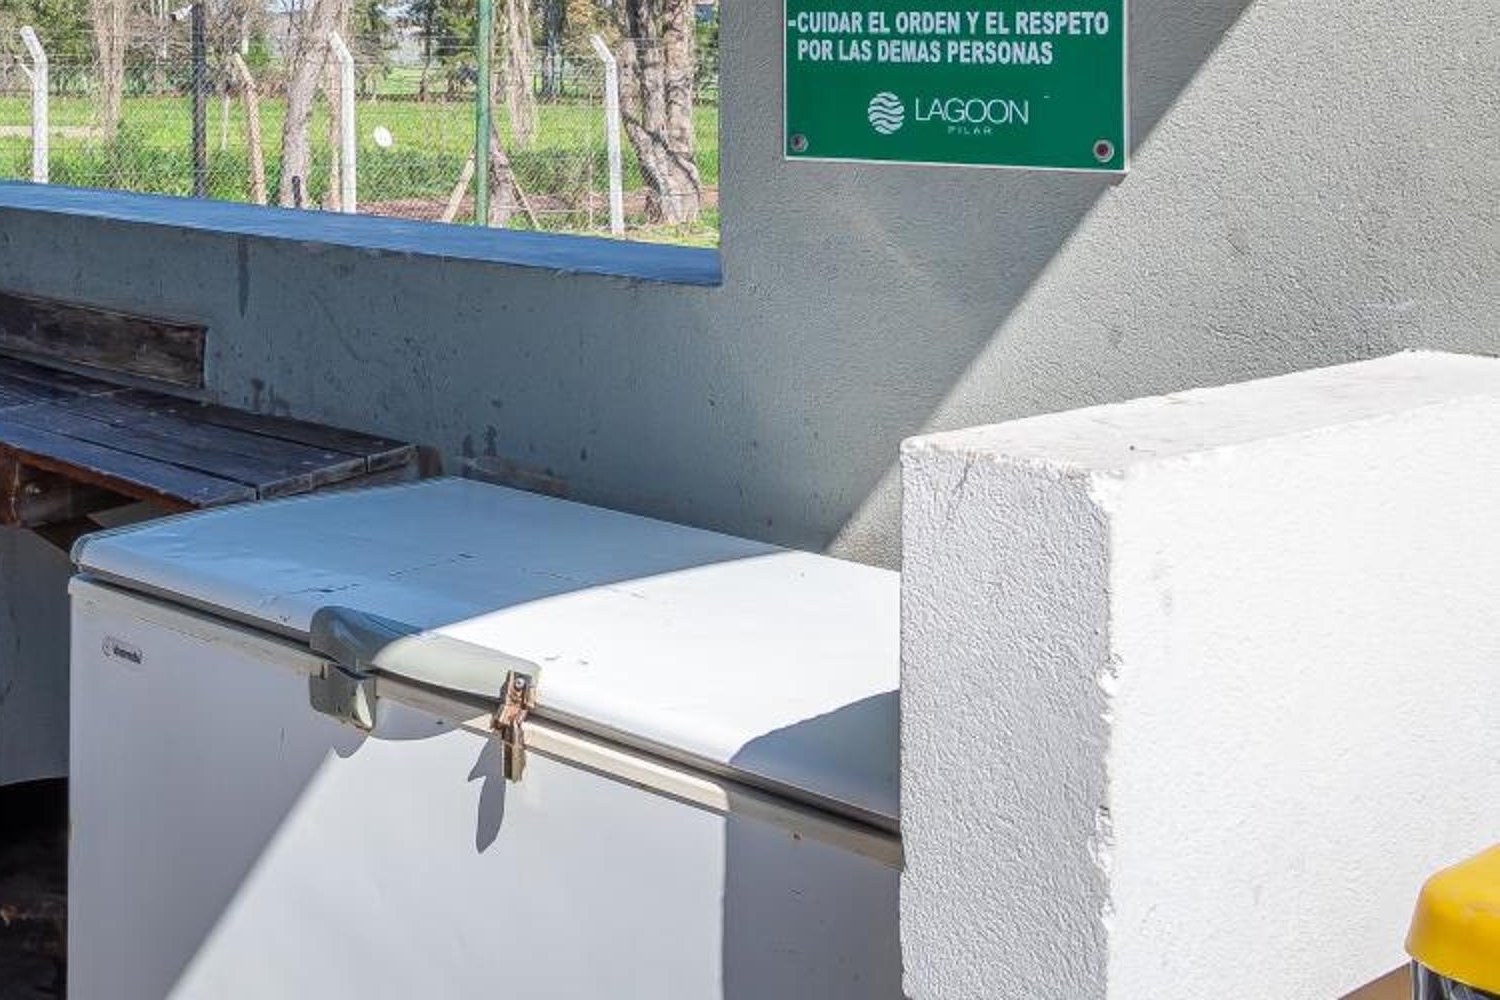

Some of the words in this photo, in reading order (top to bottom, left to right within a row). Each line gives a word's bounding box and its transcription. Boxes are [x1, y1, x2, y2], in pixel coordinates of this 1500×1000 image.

[868, 12, 890, 32] EL
[896, 12, 961, 34] ORDEN
[966, 12, 979, 34] Y
[986, 12, 1010, 35] EL
[1015, 12, 1110, 36] RESPETO
[798, 40, 833, 62] POR
[839, 40, 872, 62] LAS
[877, 40, 941, 63] DEMAS
[947, 41, 1053, 65] PERSONAS
[915, 96, 1029, 124] LAGOON
[948, 126, 992, 134] PILAR
